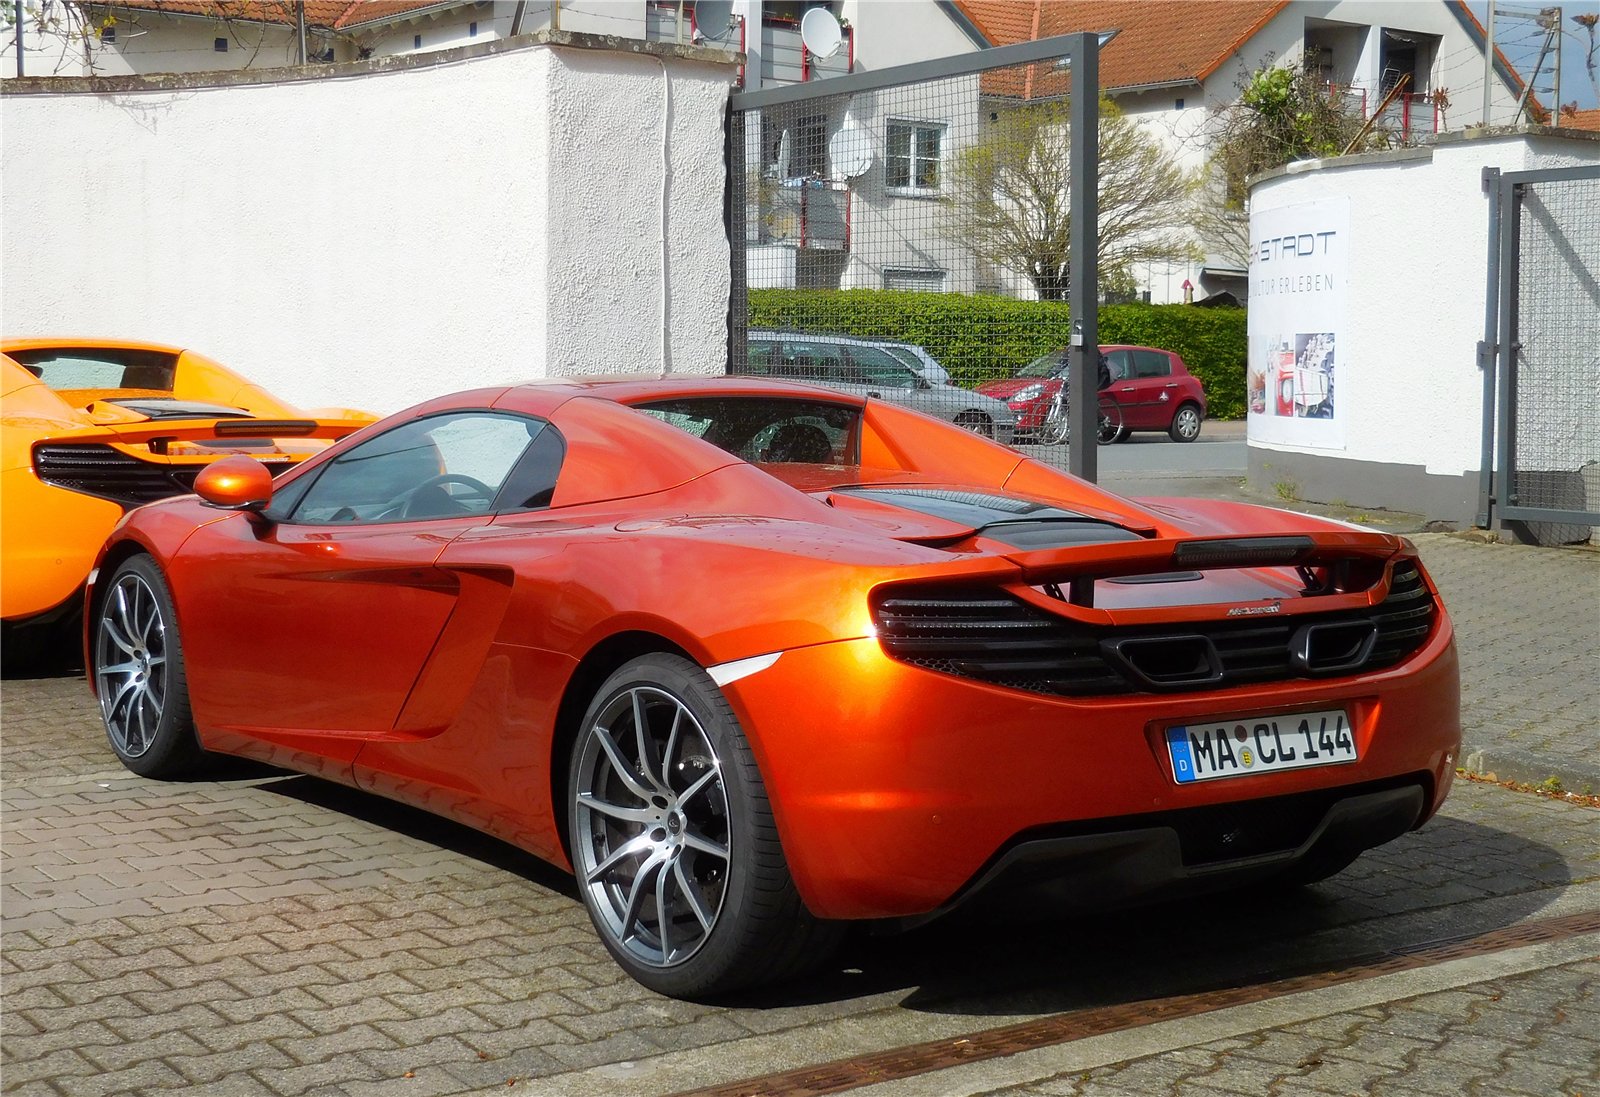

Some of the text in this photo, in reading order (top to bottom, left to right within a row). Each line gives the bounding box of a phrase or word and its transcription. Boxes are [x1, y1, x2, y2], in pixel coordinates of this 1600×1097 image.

[1279, 273, 1333, 294] ERLEBEN
[1226, 604, 1280, 617] McLaren
[1179, 715, 1352, 773] D MA CL 144
